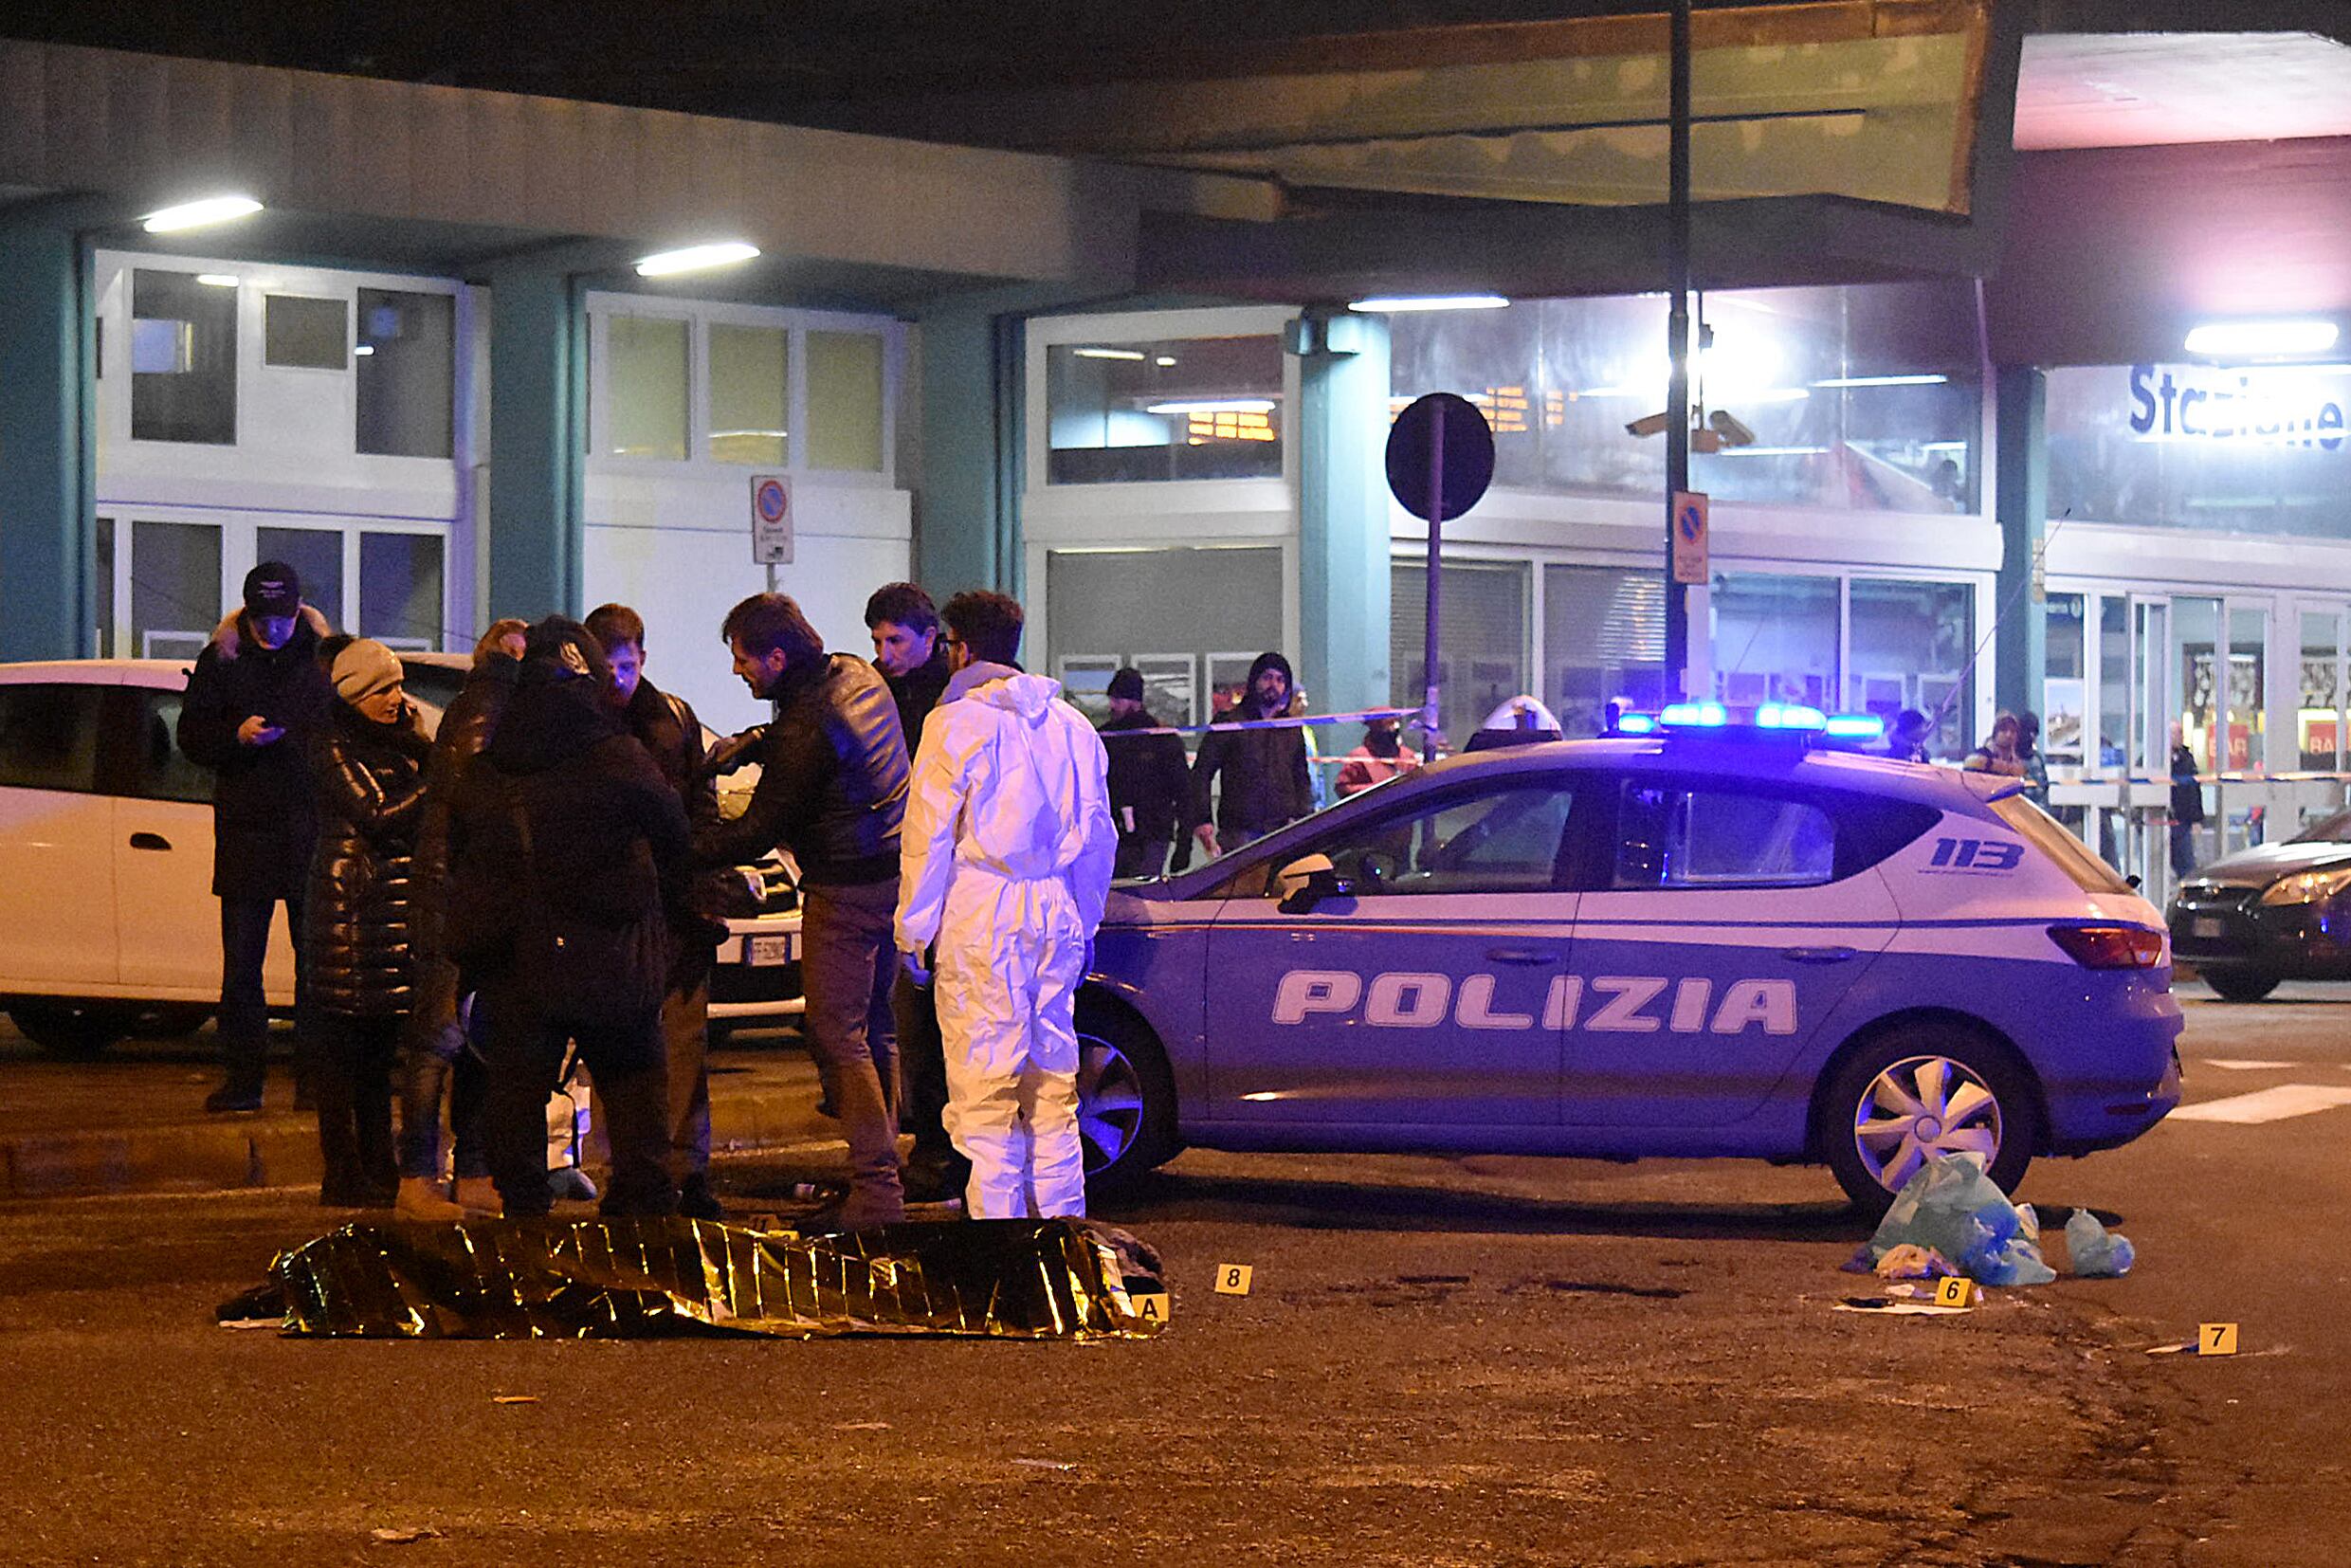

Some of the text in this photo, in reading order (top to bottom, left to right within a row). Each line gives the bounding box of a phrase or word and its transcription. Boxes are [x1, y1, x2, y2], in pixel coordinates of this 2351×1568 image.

[2130, 364, 2343, 449] Staze
[2310, 736, 2335, 755] BA
[1930, 838, 2025, 870] 113
[1271, 970, 1797, 1034] POLIZIA
[1227, 1268, 1241, 1287] 8
[1946, 1281, 1960, 1300] 6
[1141, 1298, 1158, 1319] A
[2211, 1327, 2226, 1347] 7
